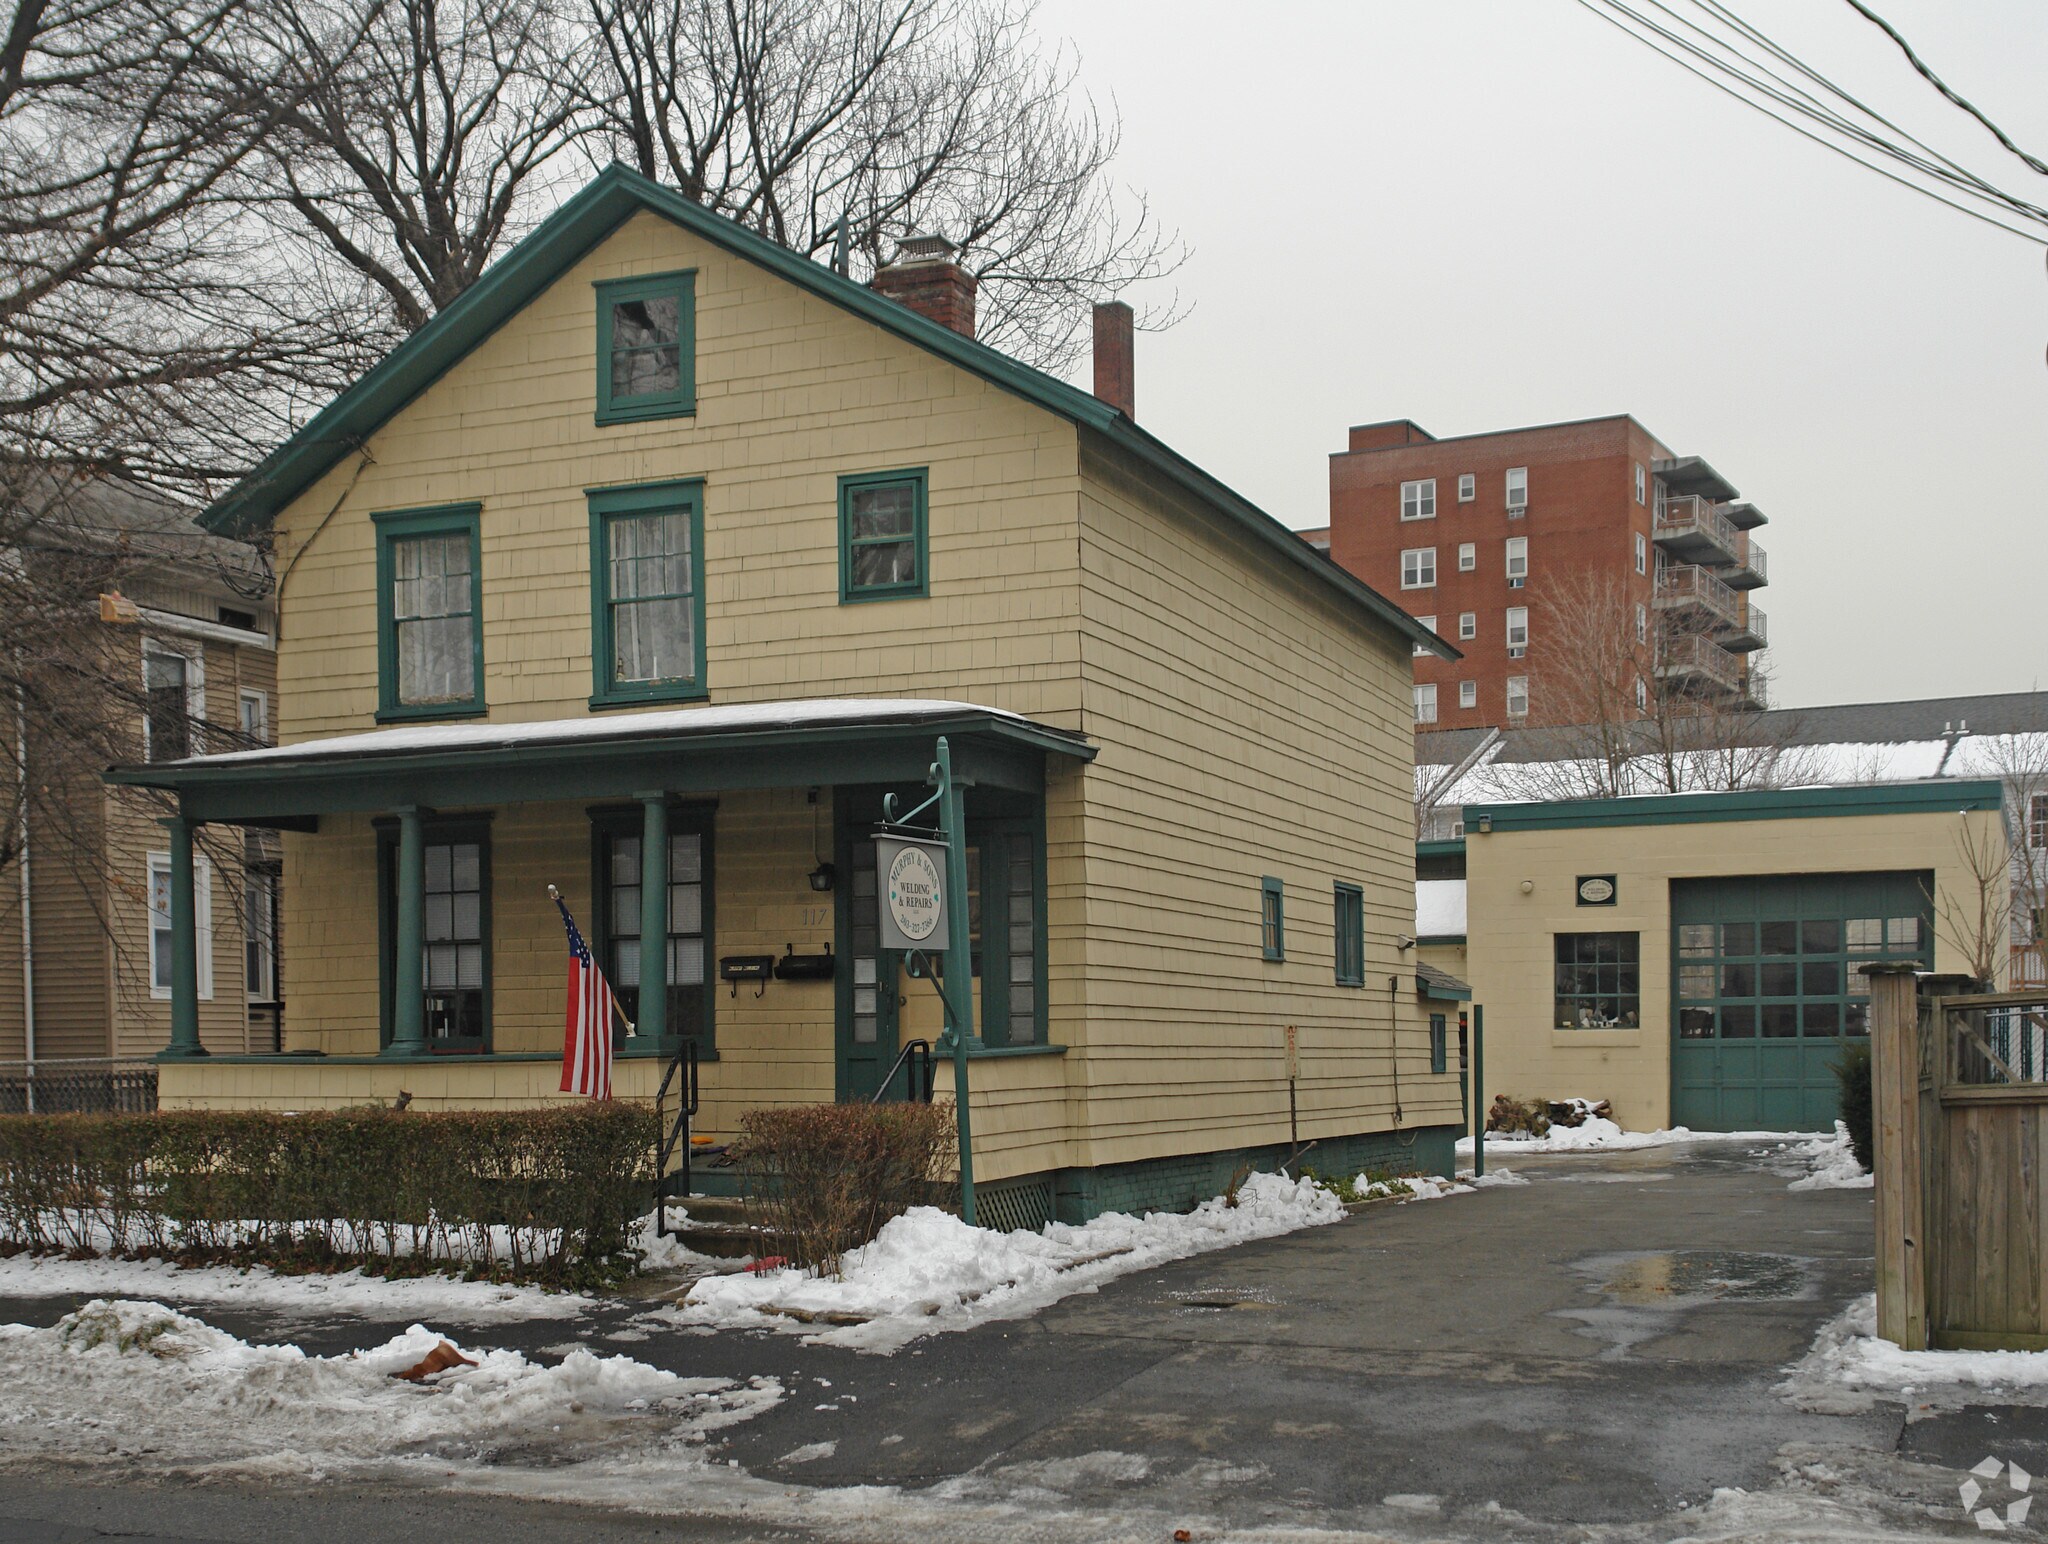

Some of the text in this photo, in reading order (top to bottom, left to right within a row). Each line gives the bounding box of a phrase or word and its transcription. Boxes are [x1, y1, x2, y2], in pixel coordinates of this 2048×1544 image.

[891, 852, 939, 889] MURPHY & SONS
[900, 882, 929, 895] WELDING
[898, 896, 933, 909] & REPAIRS
[802, 907, 827, 926] 117
